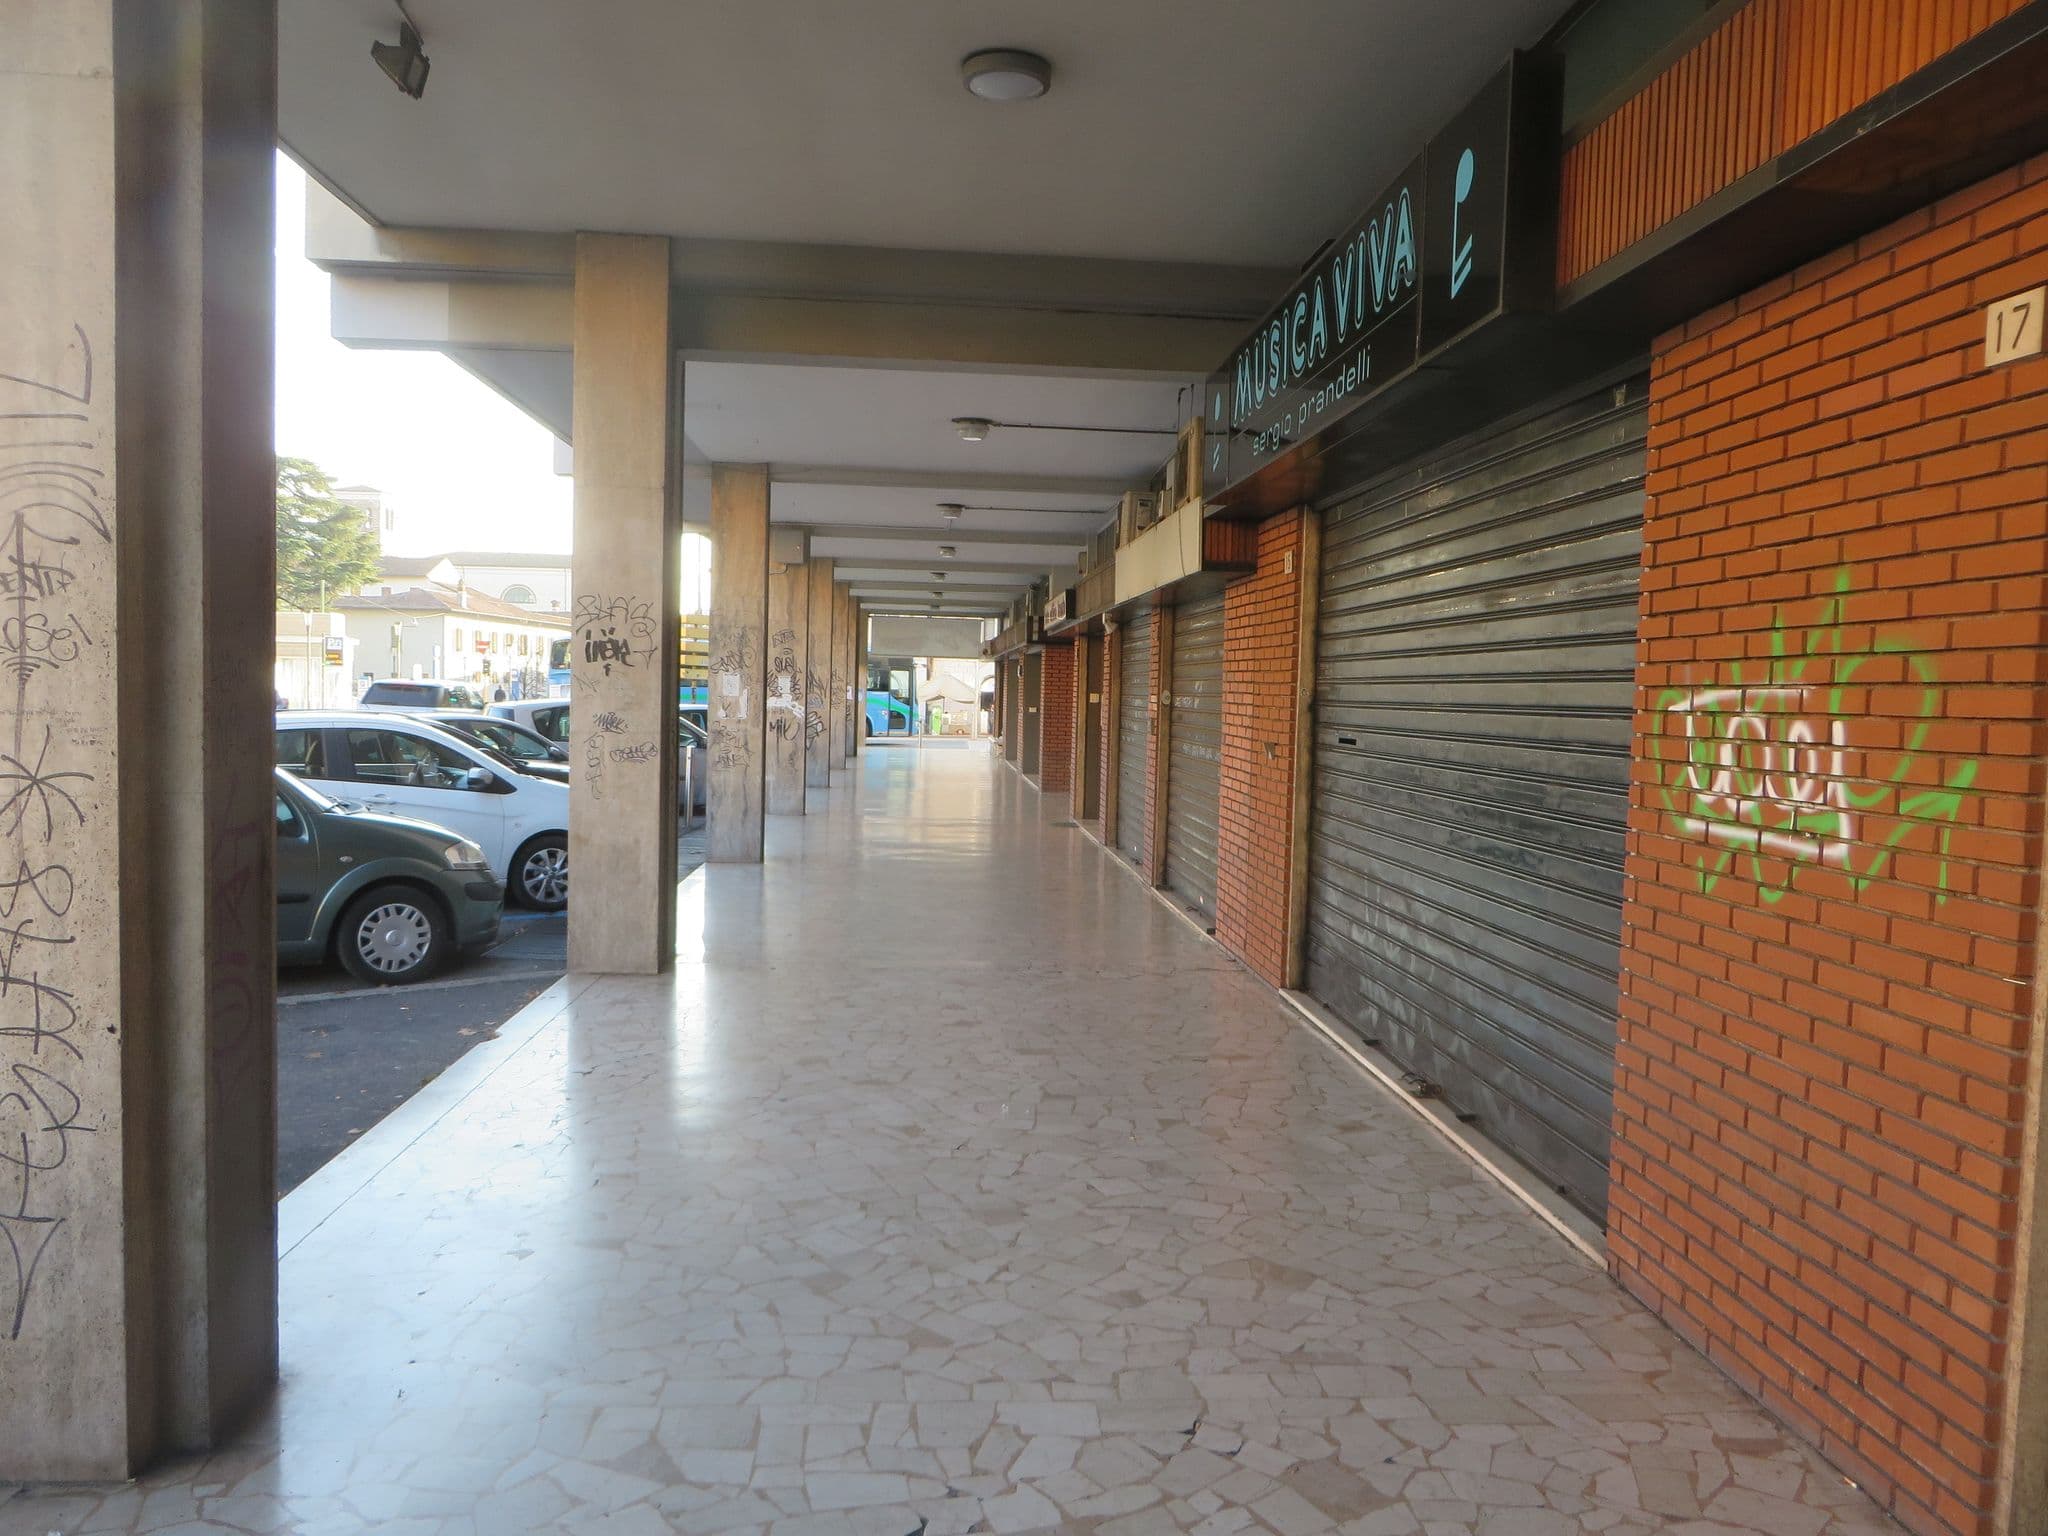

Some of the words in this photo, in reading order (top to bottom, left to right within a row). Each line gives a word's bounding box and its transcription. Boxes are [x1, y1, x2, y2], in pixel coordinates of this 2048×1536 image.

[1233, 276, 1327, 427] MUSICA
[1333, 187, 1416, 343] VIVA
[1997, 302, 2031, 354] 17
[1253, 413, 1292, 456] sergio
[1298, 345, 1371, 433] prandelli
